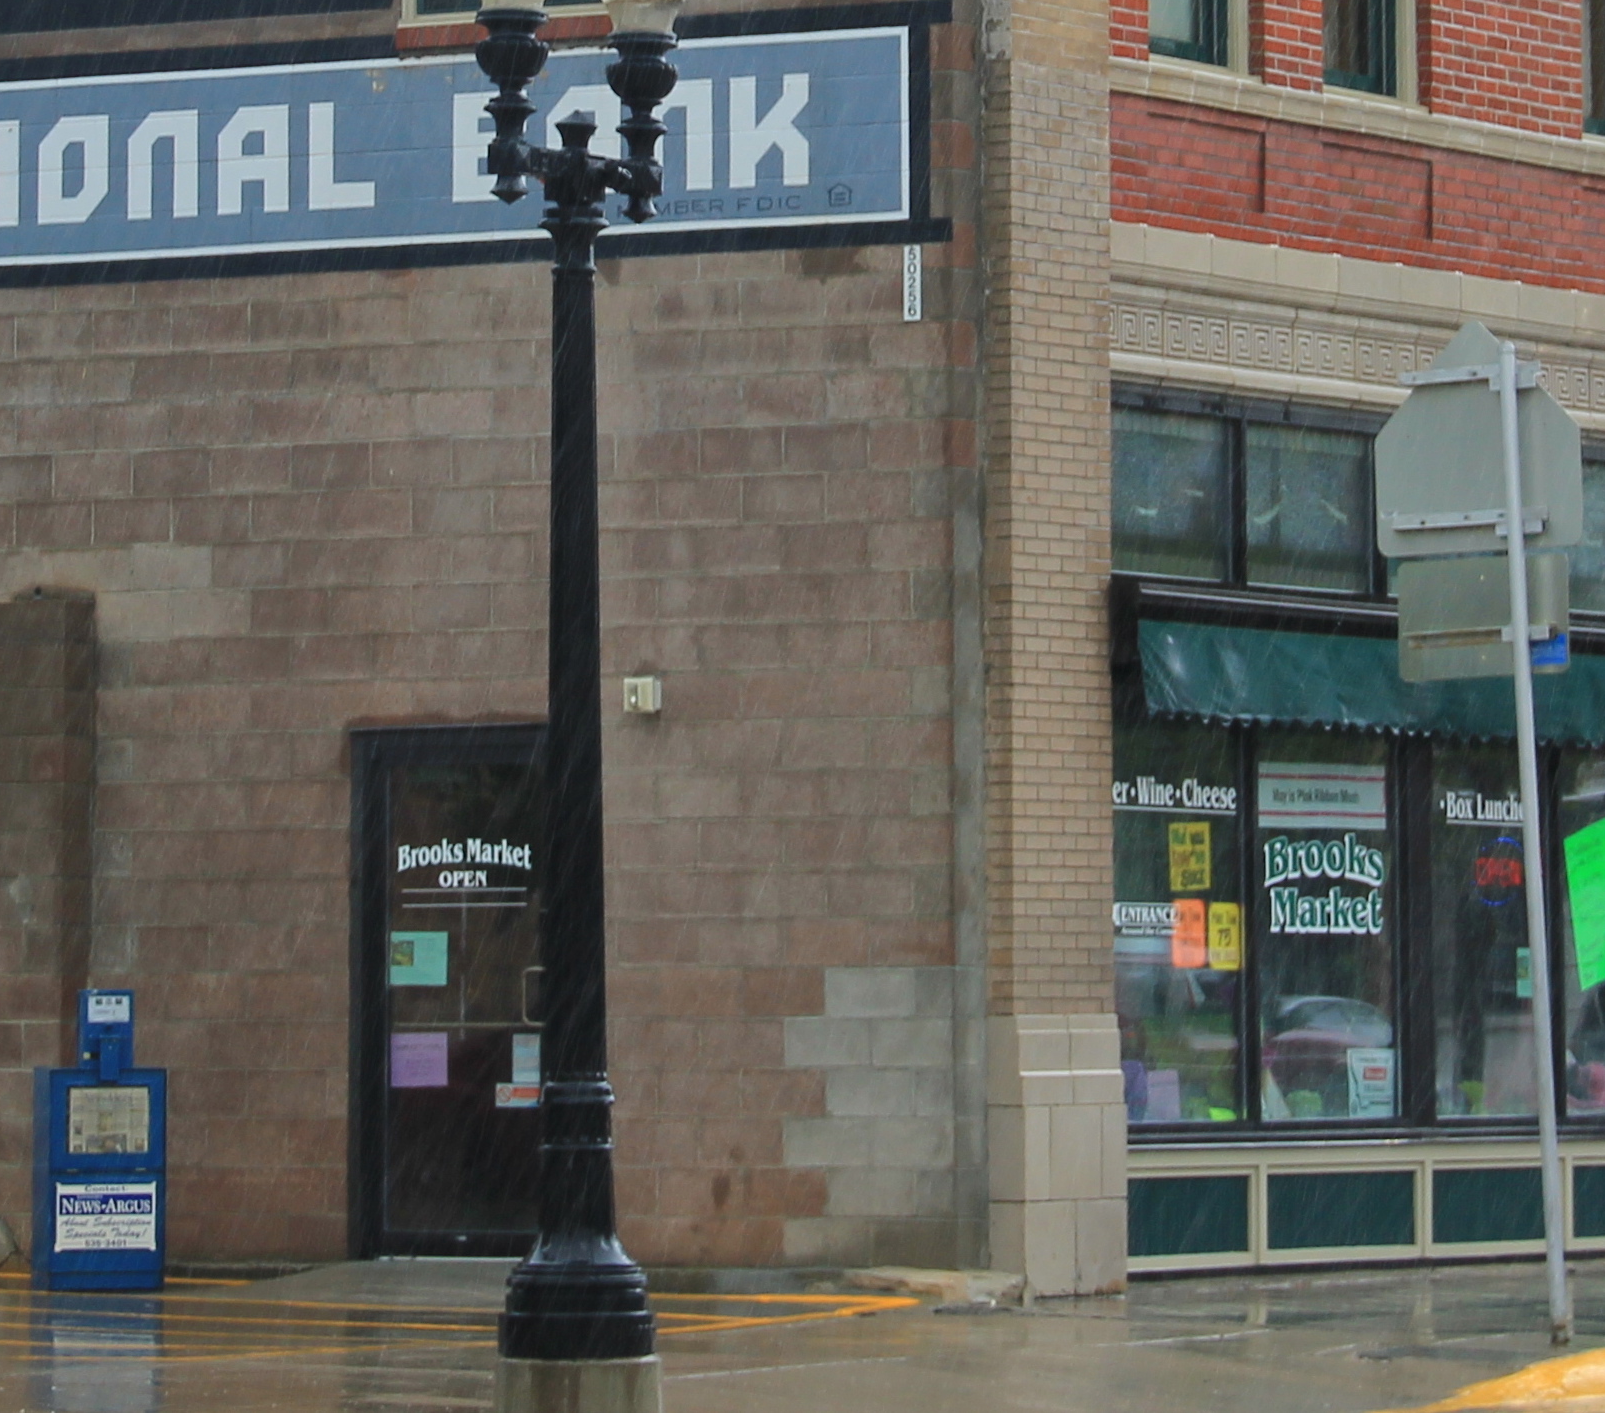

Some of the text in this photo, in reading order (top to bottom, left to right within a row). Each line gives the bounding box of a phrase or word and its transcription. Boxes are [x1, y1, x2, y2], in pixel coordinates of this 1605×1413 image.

[737, 195, 801, 212] FDIC
[1112, 780, 1130, 805] er
[1181, 778, 1237, 810] Cheese
[1446, 791, 1474, 819] Box
[397, 837, 532, 872] Brooks Market
[1263, 832, 1384, 888] Brooks
[438, 870, 487, 888] OPEN
[1121, 905, 1178, 923] ENTRANCE
[1270, 886, 1384, 935] Market
